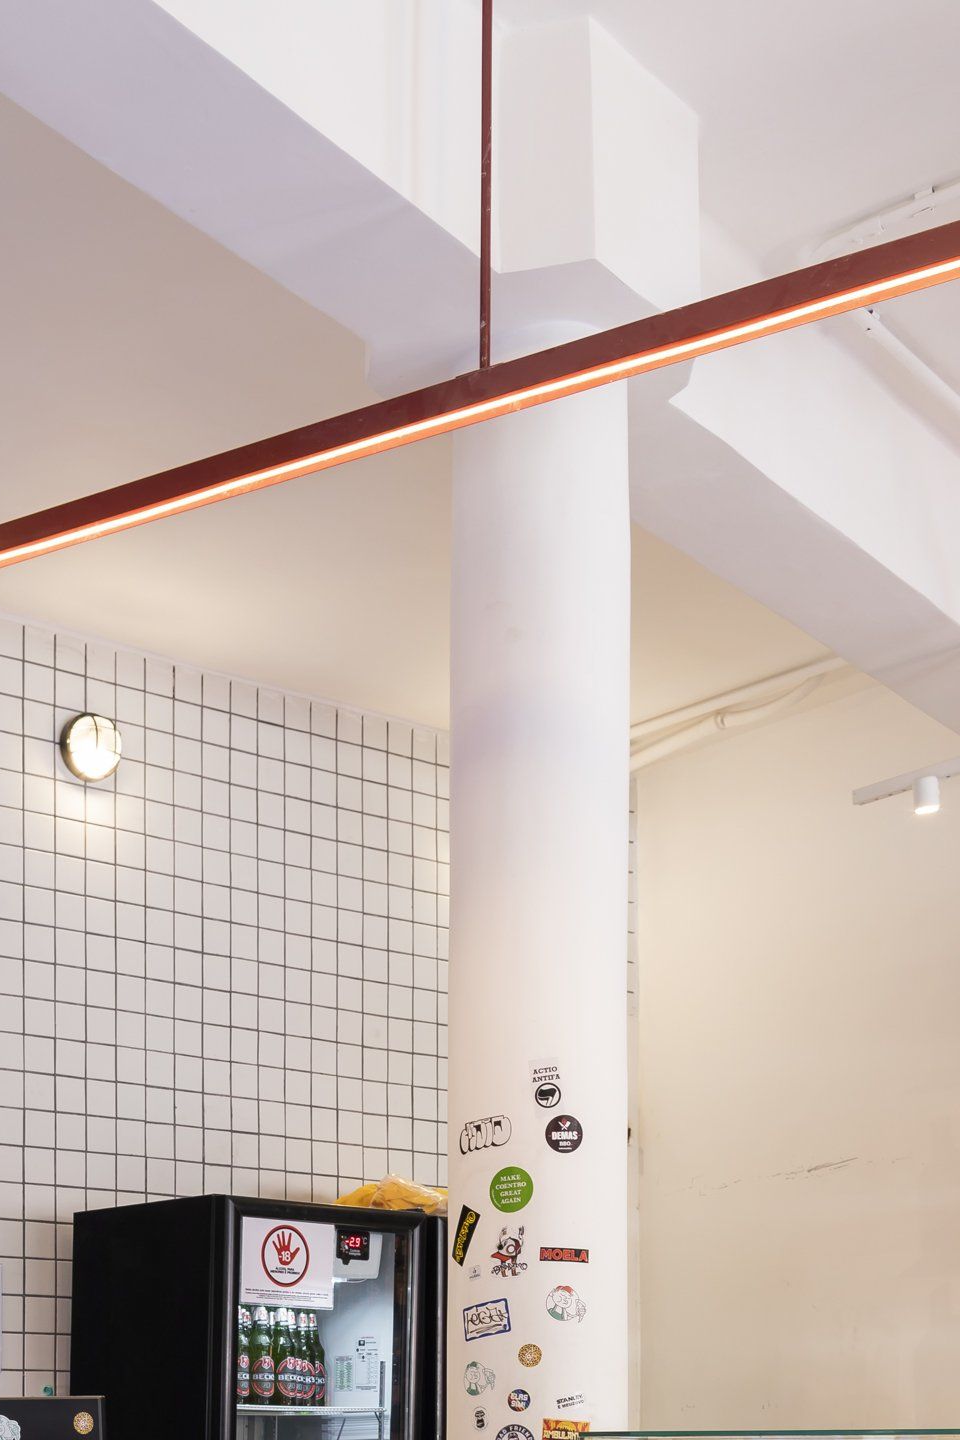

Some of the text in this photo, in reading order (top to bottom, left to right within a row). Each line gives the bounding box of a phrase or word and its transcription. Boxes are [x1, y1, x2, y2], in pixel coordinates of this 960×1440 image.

[532, 1074, 560, 1083] ANTIFA
[551, 1131, 578, 1140] DEMAS
[500, 1174, 521, 1182] MAKE
[495, 1181, 527, 1190] COENTRO
[540, 1247, 589, 1263] MOELA
